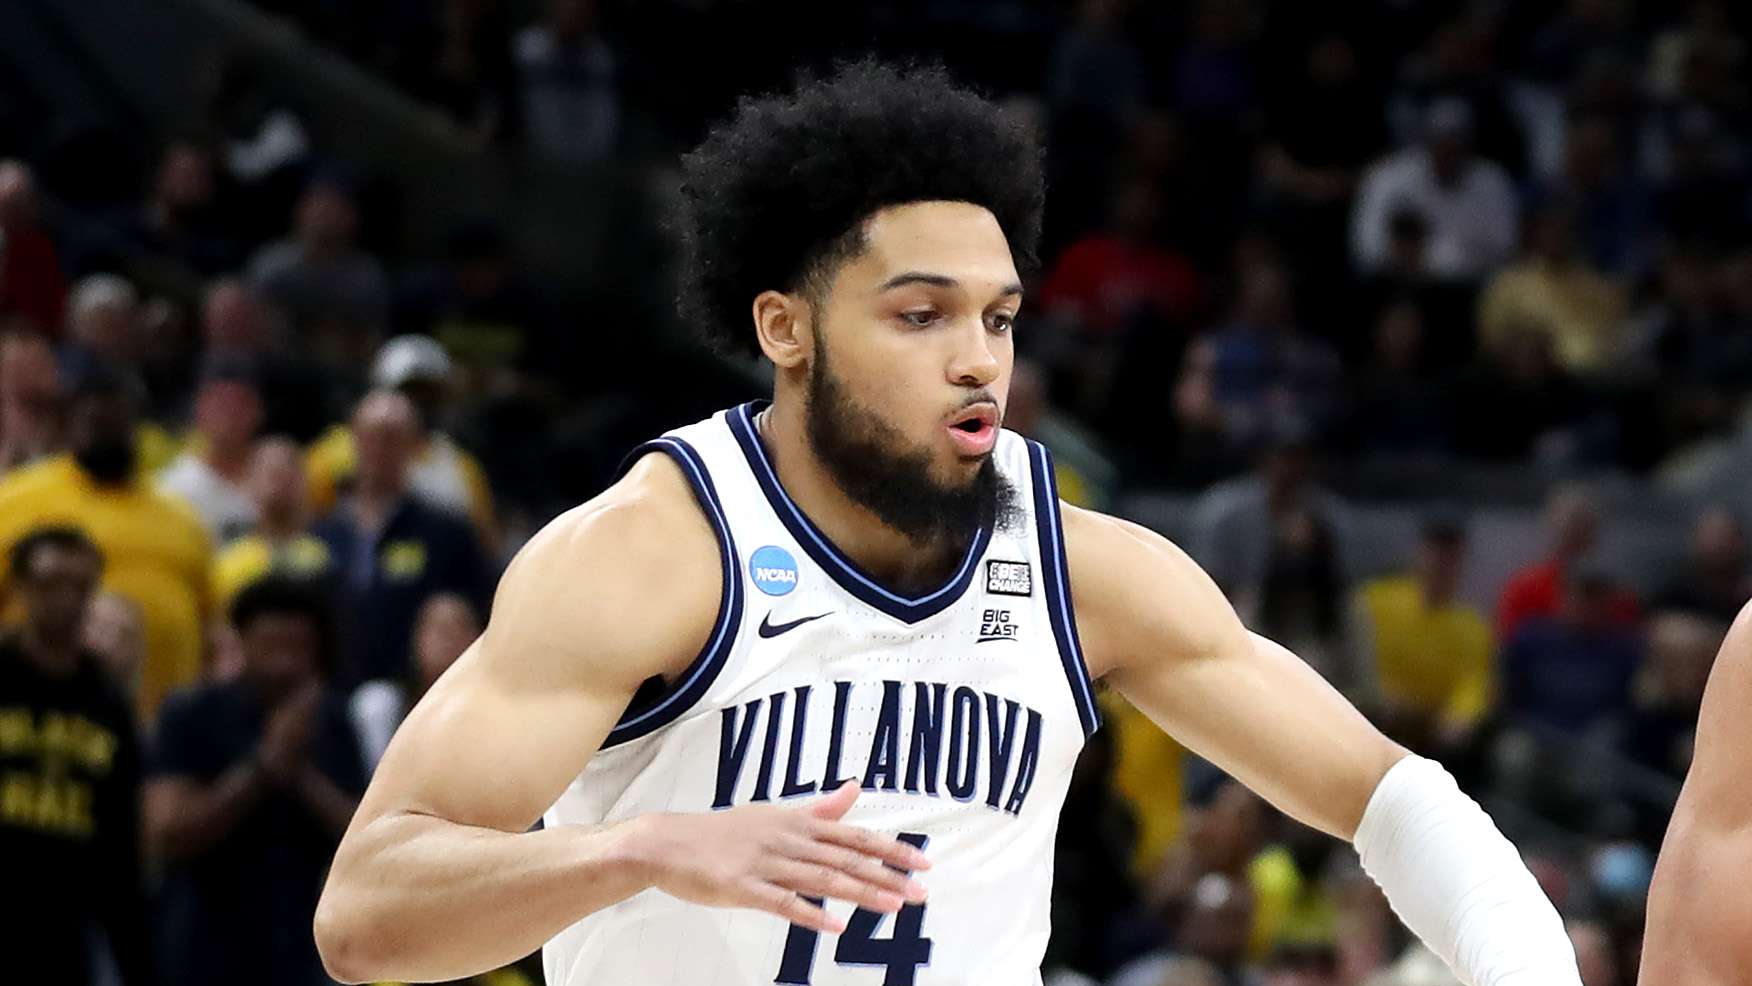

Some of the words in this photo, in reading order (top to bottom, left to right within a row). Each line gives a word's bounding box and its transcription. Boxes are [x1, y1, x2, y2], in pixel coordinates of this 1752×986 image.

[756, 567, 797, 584] NCAA
[982, 609, 1011, 623] BIG
[980, 623, 1019, 636] EAST
[711, 679, 1043, 818] VILLANOVA
